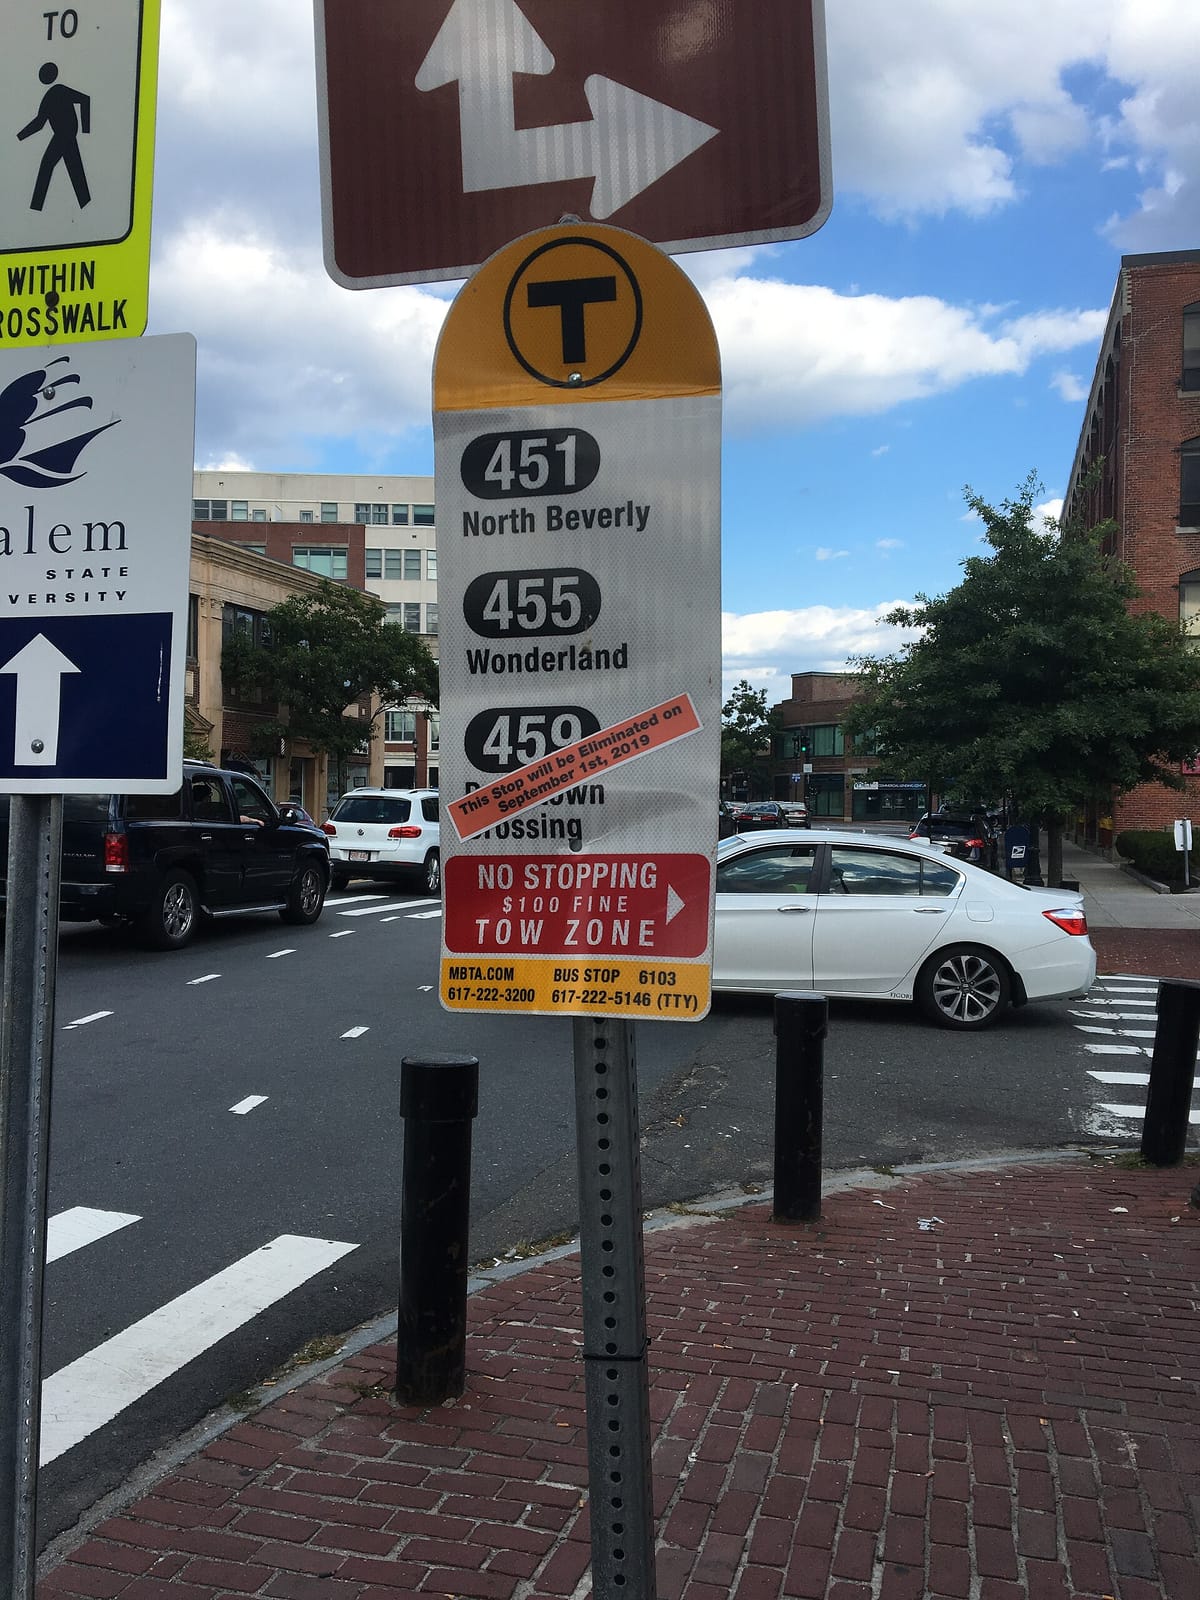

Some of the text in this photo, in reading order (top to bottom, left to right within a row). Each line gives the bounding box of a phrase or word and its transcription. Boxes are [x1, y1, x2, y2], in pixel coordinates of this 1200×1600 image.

[43, 9, 78, 40] TO
[7, 260, 96, 297] WITHIN
[0, 299, 128, 338] OSSWALK
[527, 276, 616, 364] T
[484, 434, 577, 491] 451
[463, 501, 651, 537] North Beverly
[46, 566, 129, 580] STATE
[482, 576, 582, 630] 455
[467, 643, 628, 674] Wonderland
[458, 705, 682, 815] This Stop will be Eliminated on
[498, 734, 650, 812] September 1st, 2019
[477, 862, 657, 890] NO STOPPING
[502, 895, 628, 914] $100 FINE
[475, 919, 655, 947] TOW ZONE
[449, 967, 514, 981] MBTA.COM
[553, 968, 676, 986] BUS STOP 6103
[448, 988, 535, 1003] 617-222-3200
[552, 990, 698, 1012] 617-222-5146 (TTY)
